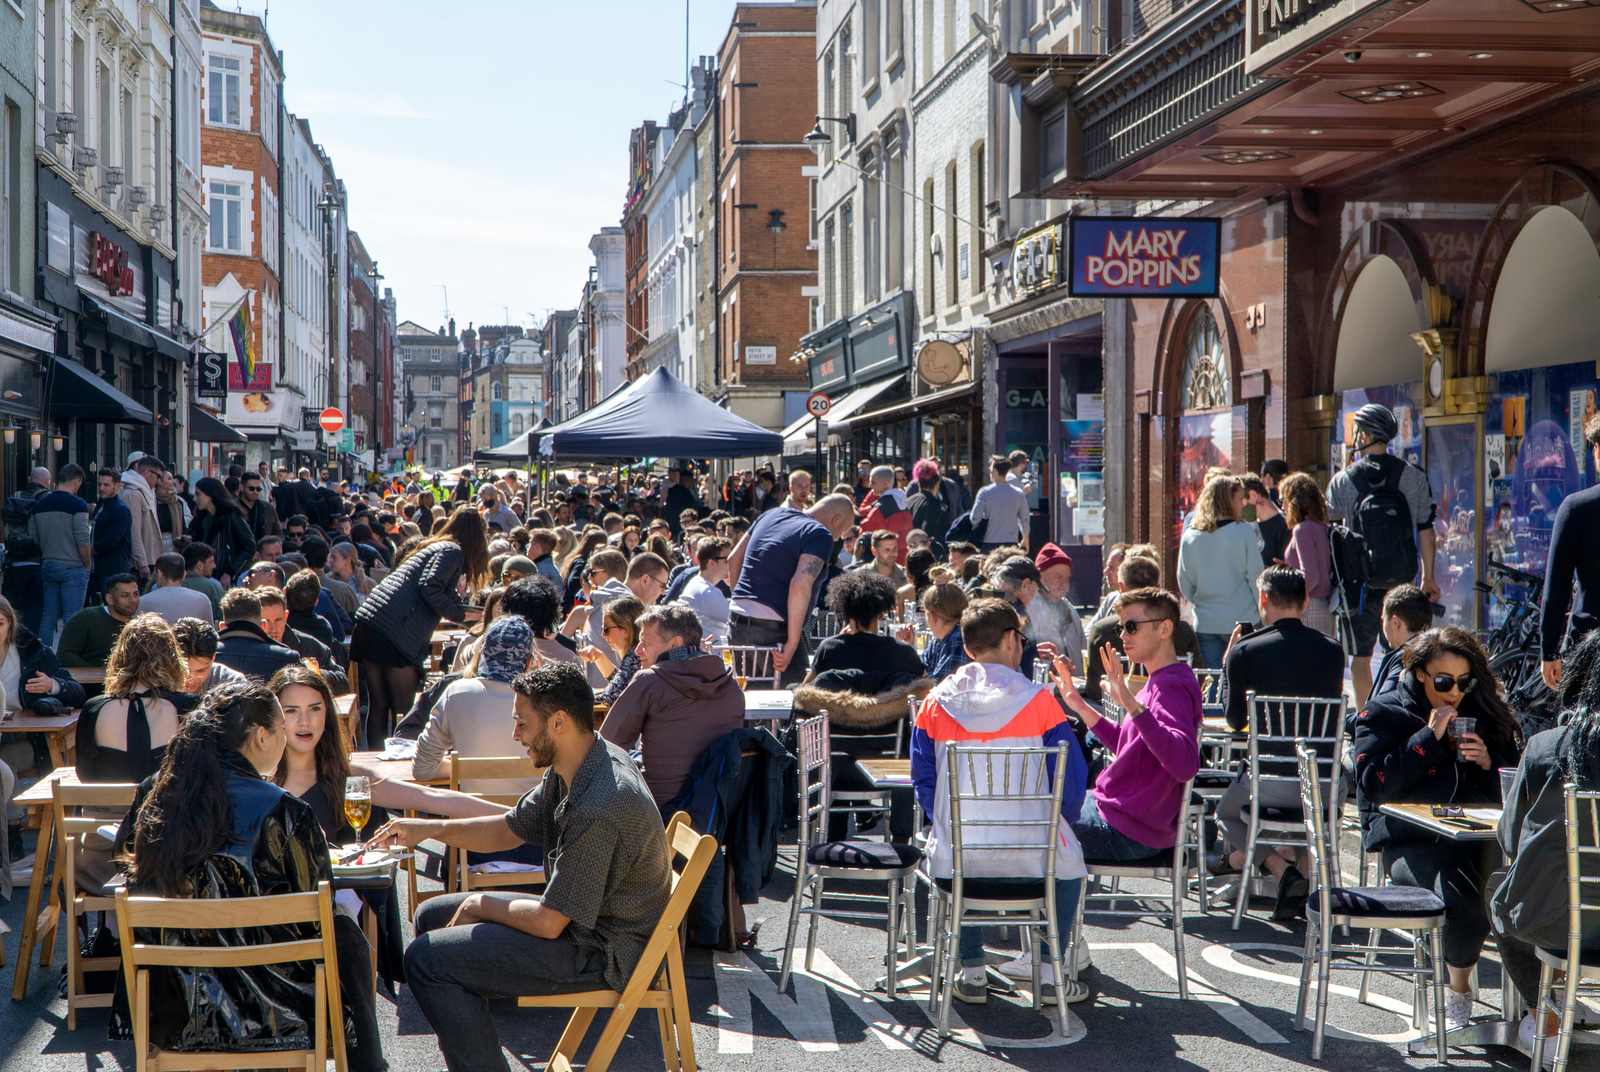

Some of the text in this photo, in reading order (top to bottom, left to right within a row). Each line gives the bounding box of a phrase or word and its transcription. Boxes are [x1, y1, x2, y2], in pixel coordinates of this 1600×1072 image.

[1105, 226, 1186, 258] MARY
[1085, 255, 1201, 288] POPPINS
[812, 400, 828, 410] 20
[1007, 389, 1049, 408] G-A
